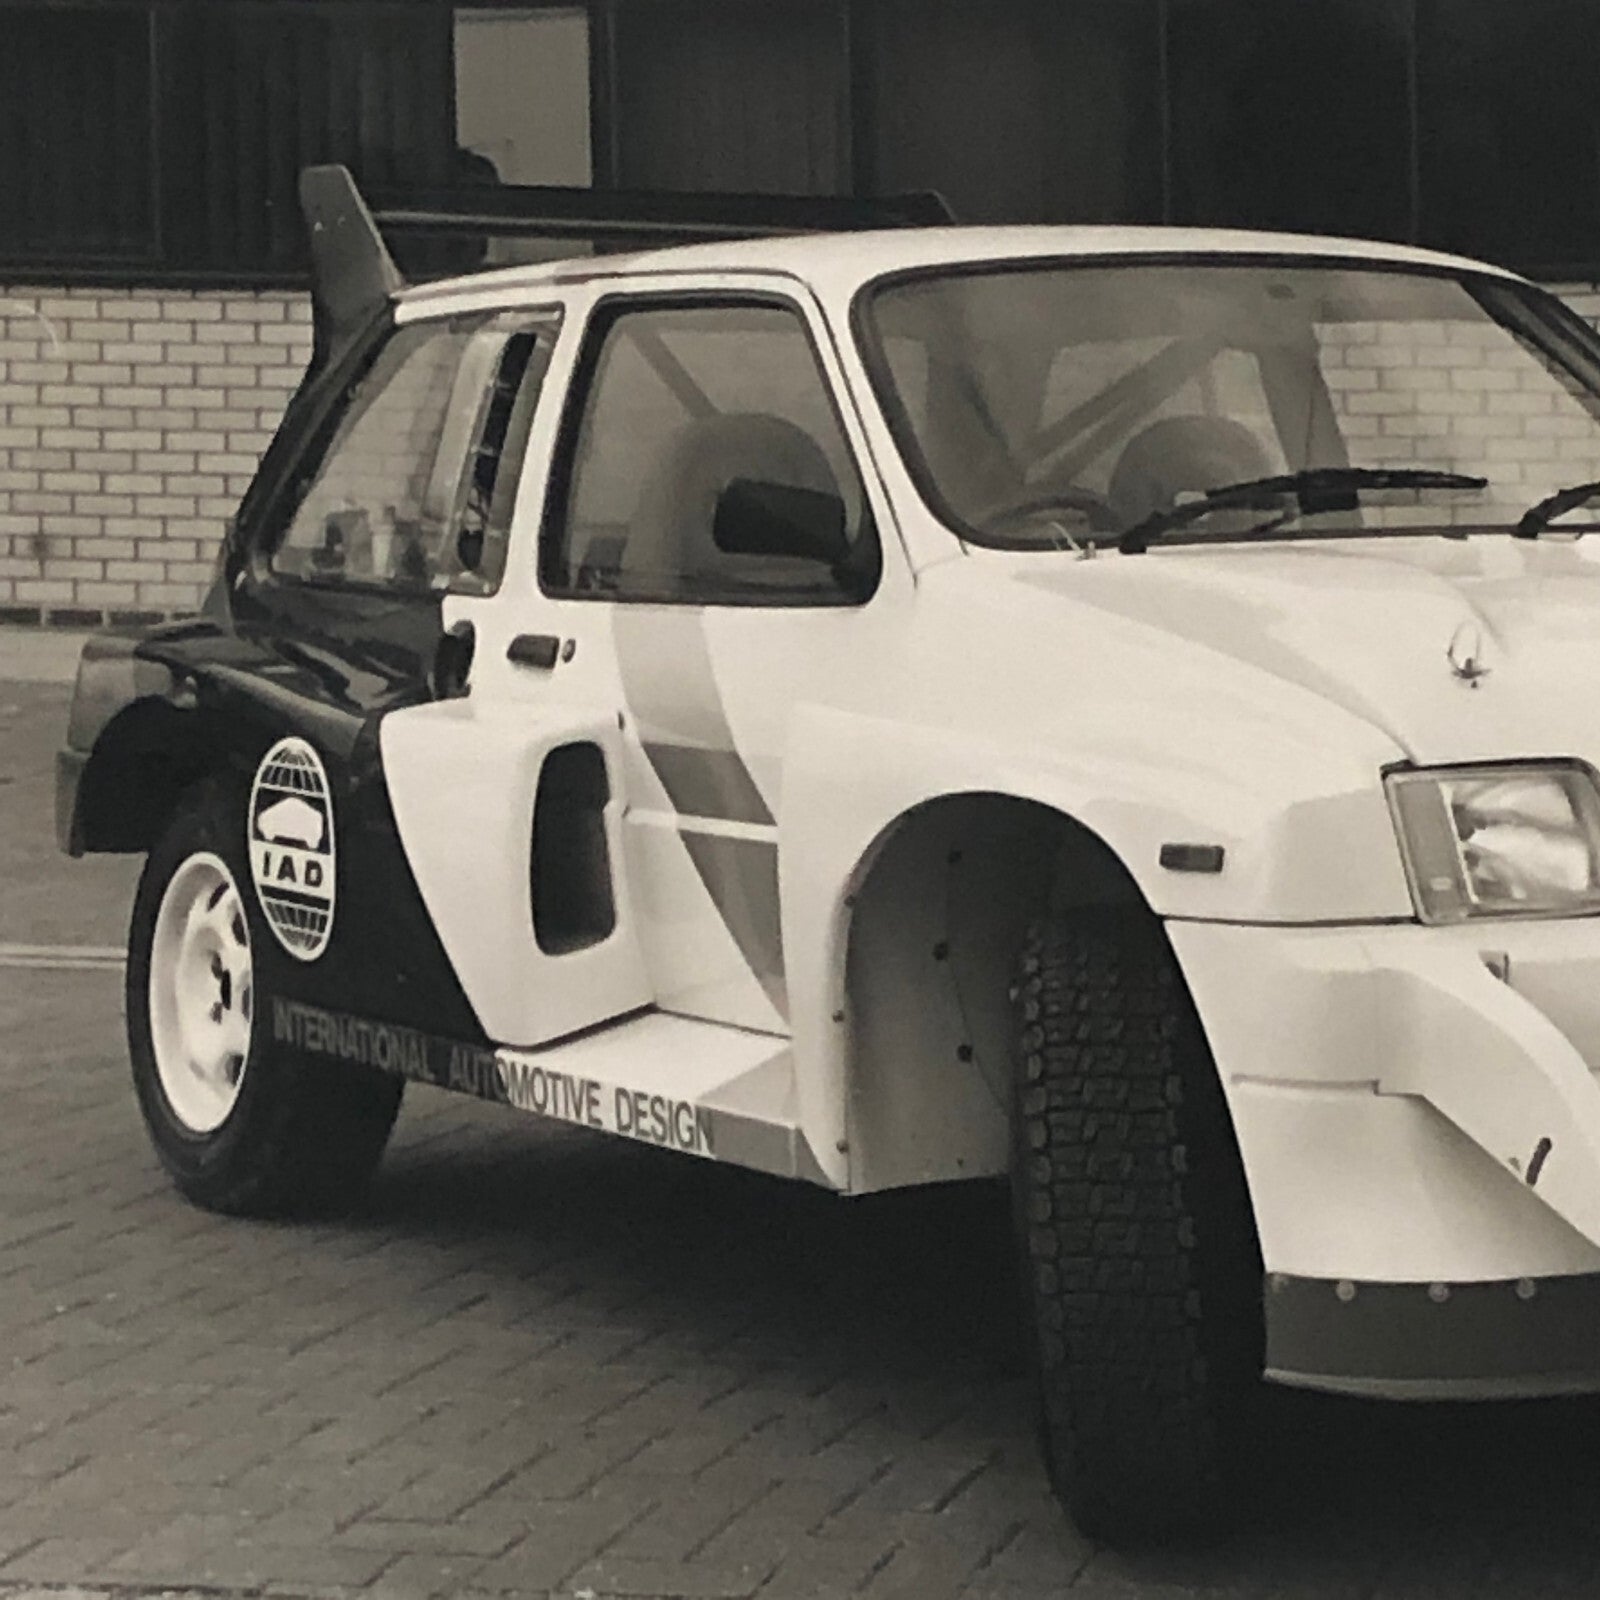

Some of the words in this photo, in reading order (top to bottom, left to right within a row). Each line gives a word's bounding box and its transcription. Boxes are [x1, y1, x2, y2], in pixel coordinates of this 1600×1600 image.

[263, 851, 323, 887] IAD
[273, 1001, 435, 1080] INTERNATIONAL
[448, 1045, 603, 1126] AUTOMOTIVE
[614, 1086, 715, 1155] DESIGN
